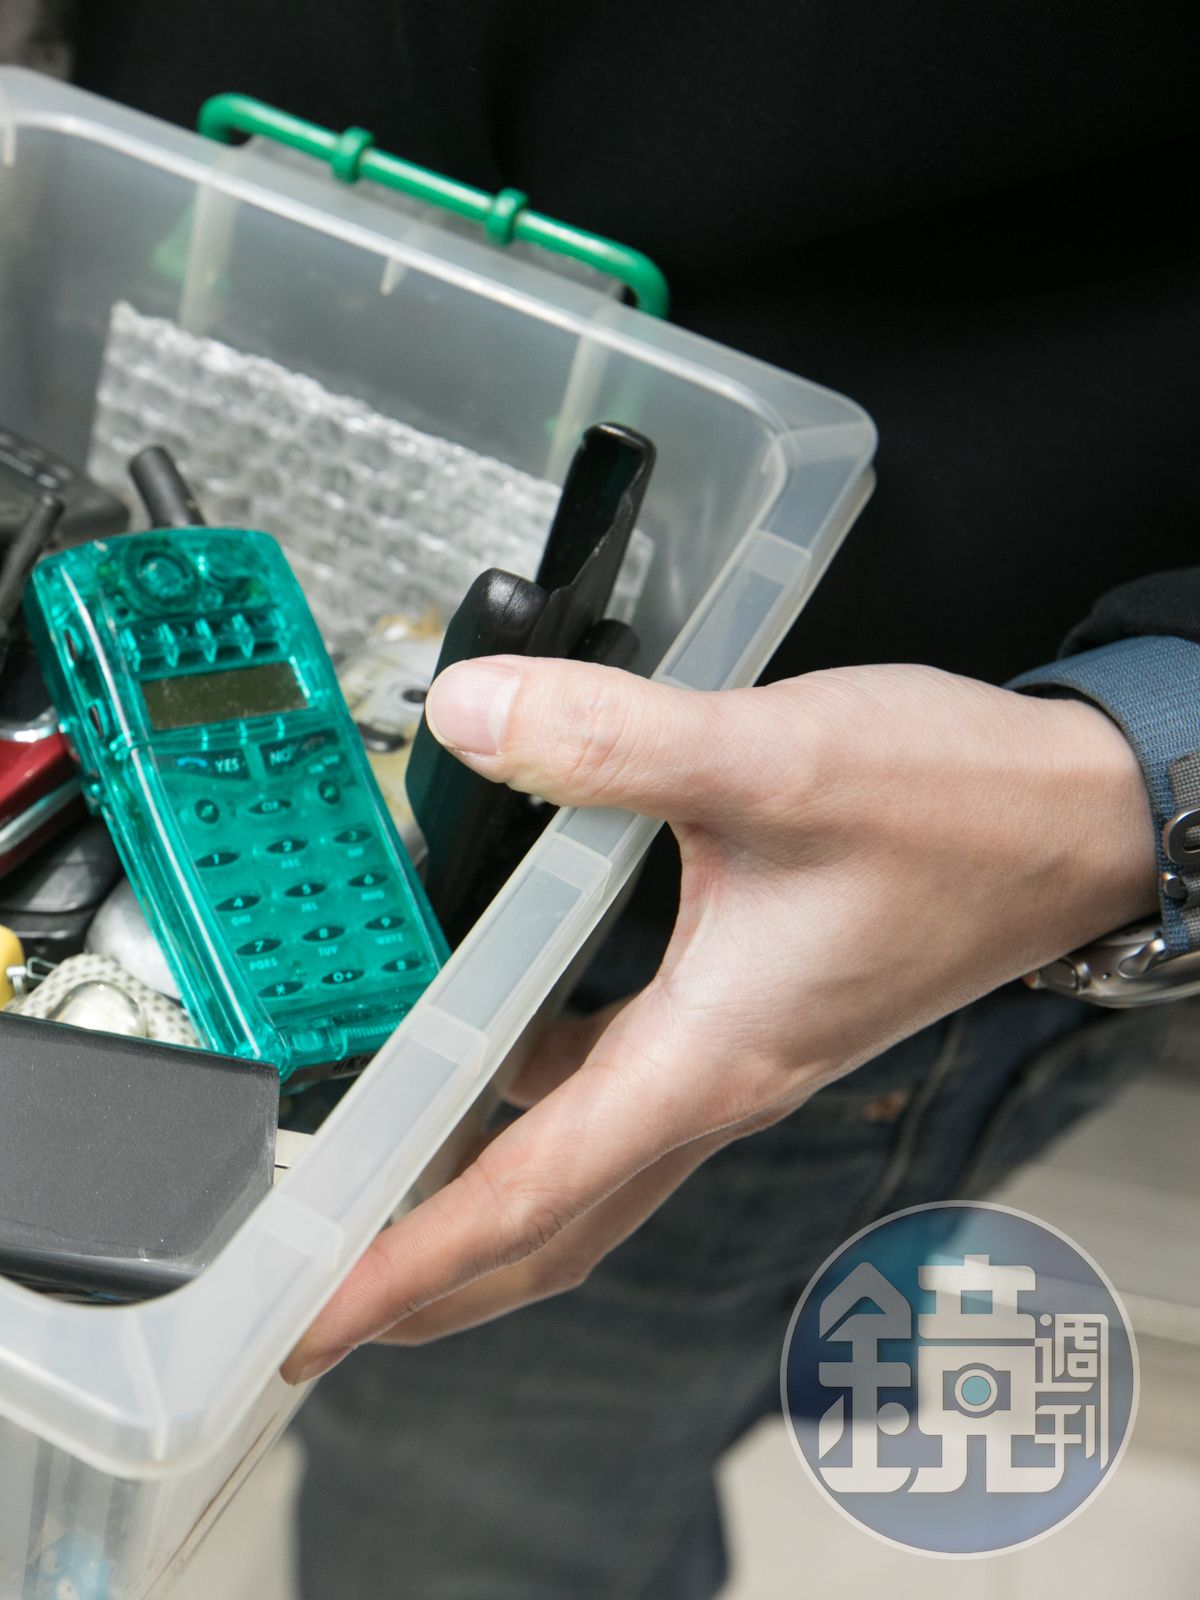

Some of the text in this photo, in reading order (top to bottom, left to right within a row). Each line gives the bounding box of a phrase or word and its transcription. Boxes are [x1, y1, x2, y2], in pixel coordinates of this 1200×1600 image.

[269, 746, 293, 765] NO
[215, 757, 240, 773] YES
[282, 840, 292, 852] 2
[212, 853, 220, 864] 1
[301, 883, 311, 895] 5
[233, 896, 244, 907] 4
[255, 940, 264, 953] 7
